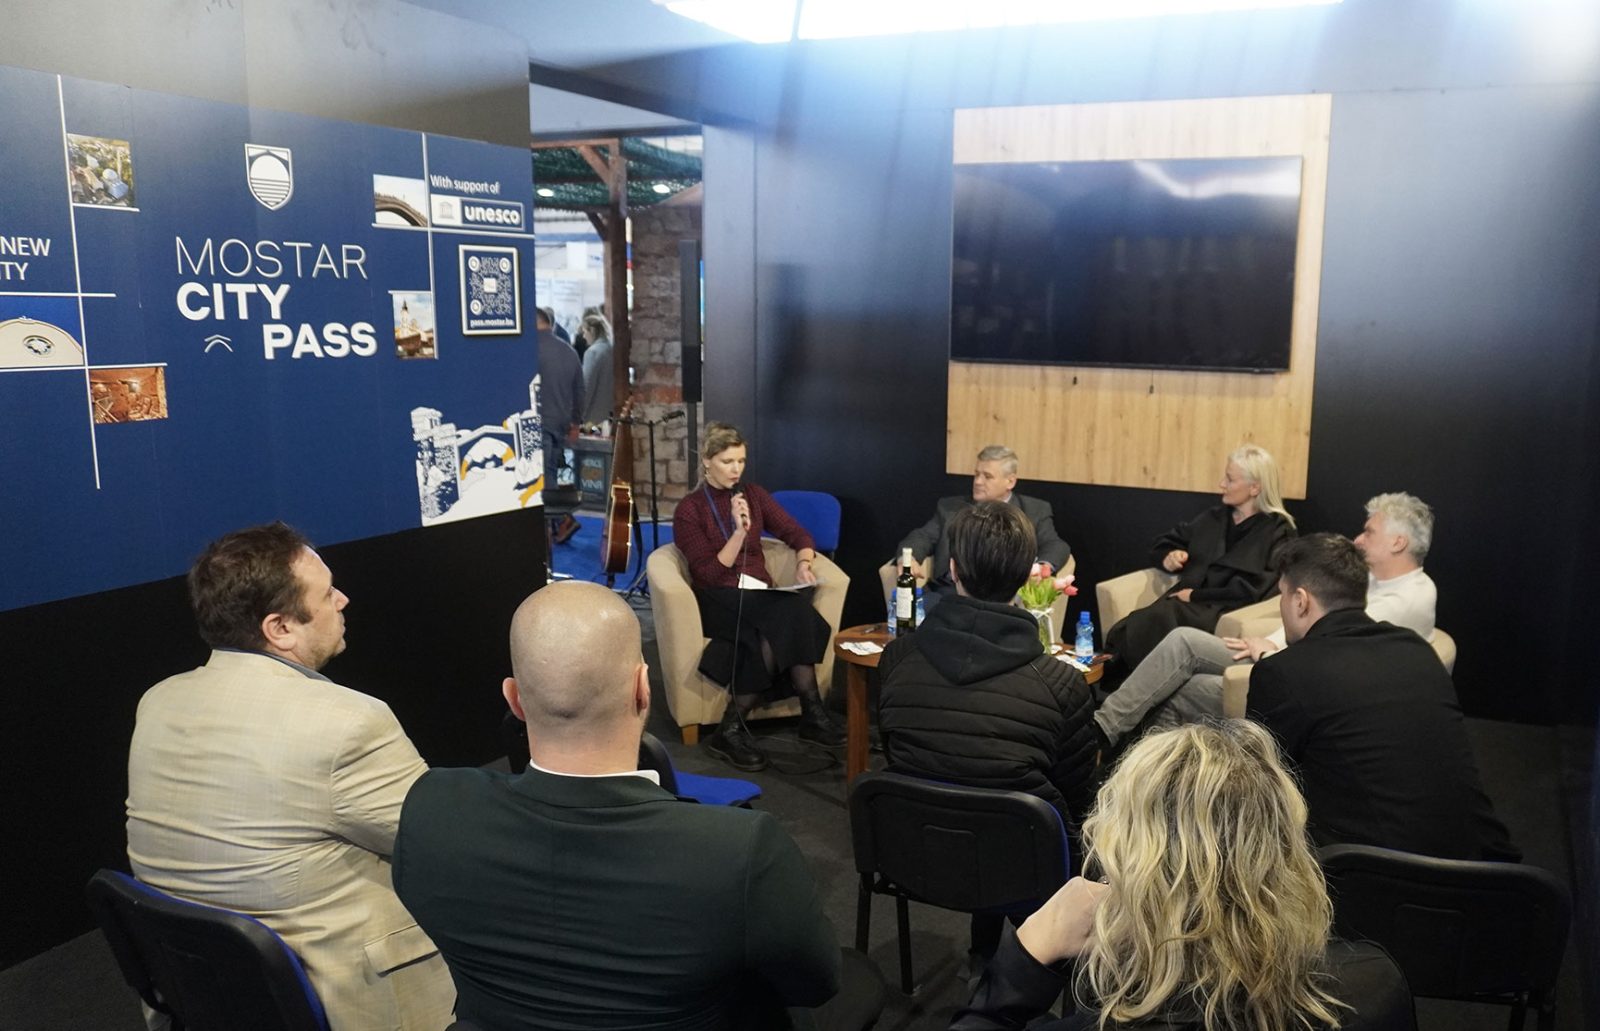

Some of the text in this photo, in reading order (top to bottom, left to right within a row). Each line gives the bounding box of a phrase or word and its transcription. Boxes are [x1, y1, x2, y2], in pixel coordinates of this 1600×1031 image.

[430, 174, 500, 194] With support of
[464, 205, 521, 225] unesco
[0, 236, 51, 257] NEW
[175, 236, 368, 280] MOSTAR
[0, 261, 29, 281] TY
[176, 282, 290, 321] CITY
[262, 322, 378, 360] PASS
